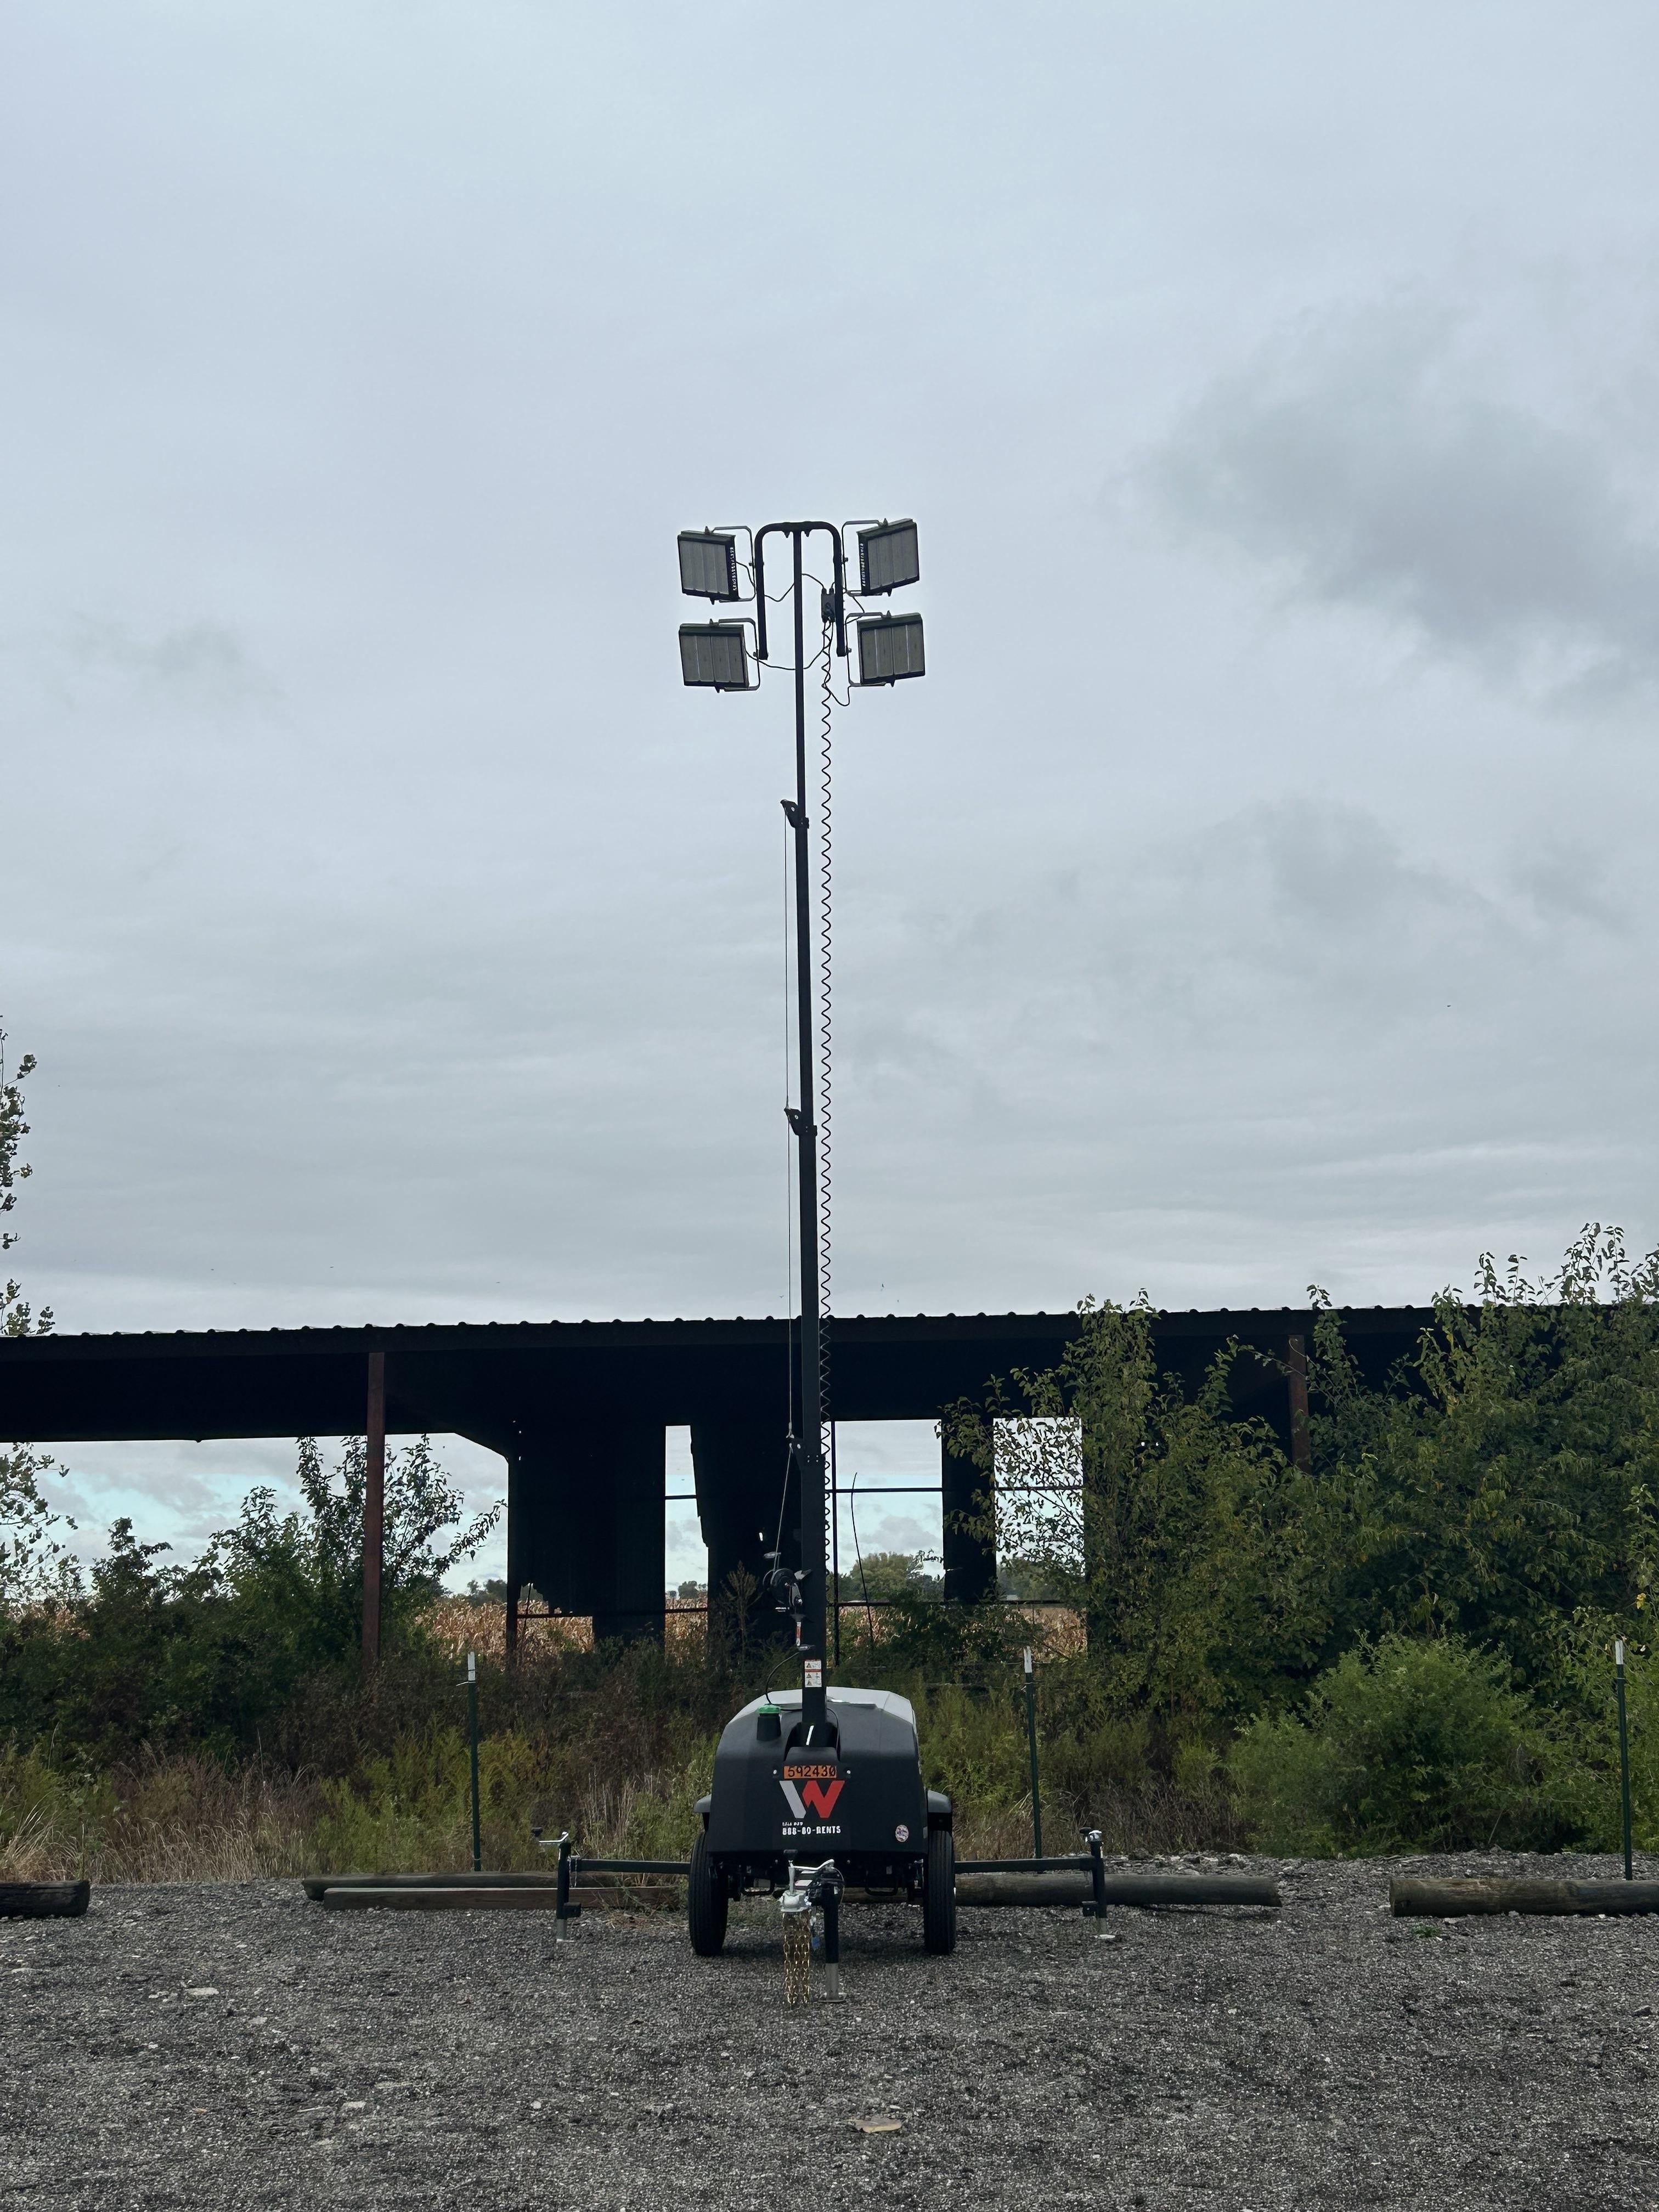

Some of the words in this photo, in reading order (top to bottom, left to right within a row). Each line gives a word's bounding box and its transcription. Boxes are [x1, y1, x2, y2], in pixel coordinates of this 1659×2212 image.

[788, 1765, 836, 1778] 592430
[779, 1780, 845, 1819] W
[782, 1826, 841, 1835] 888-80-RENTS
